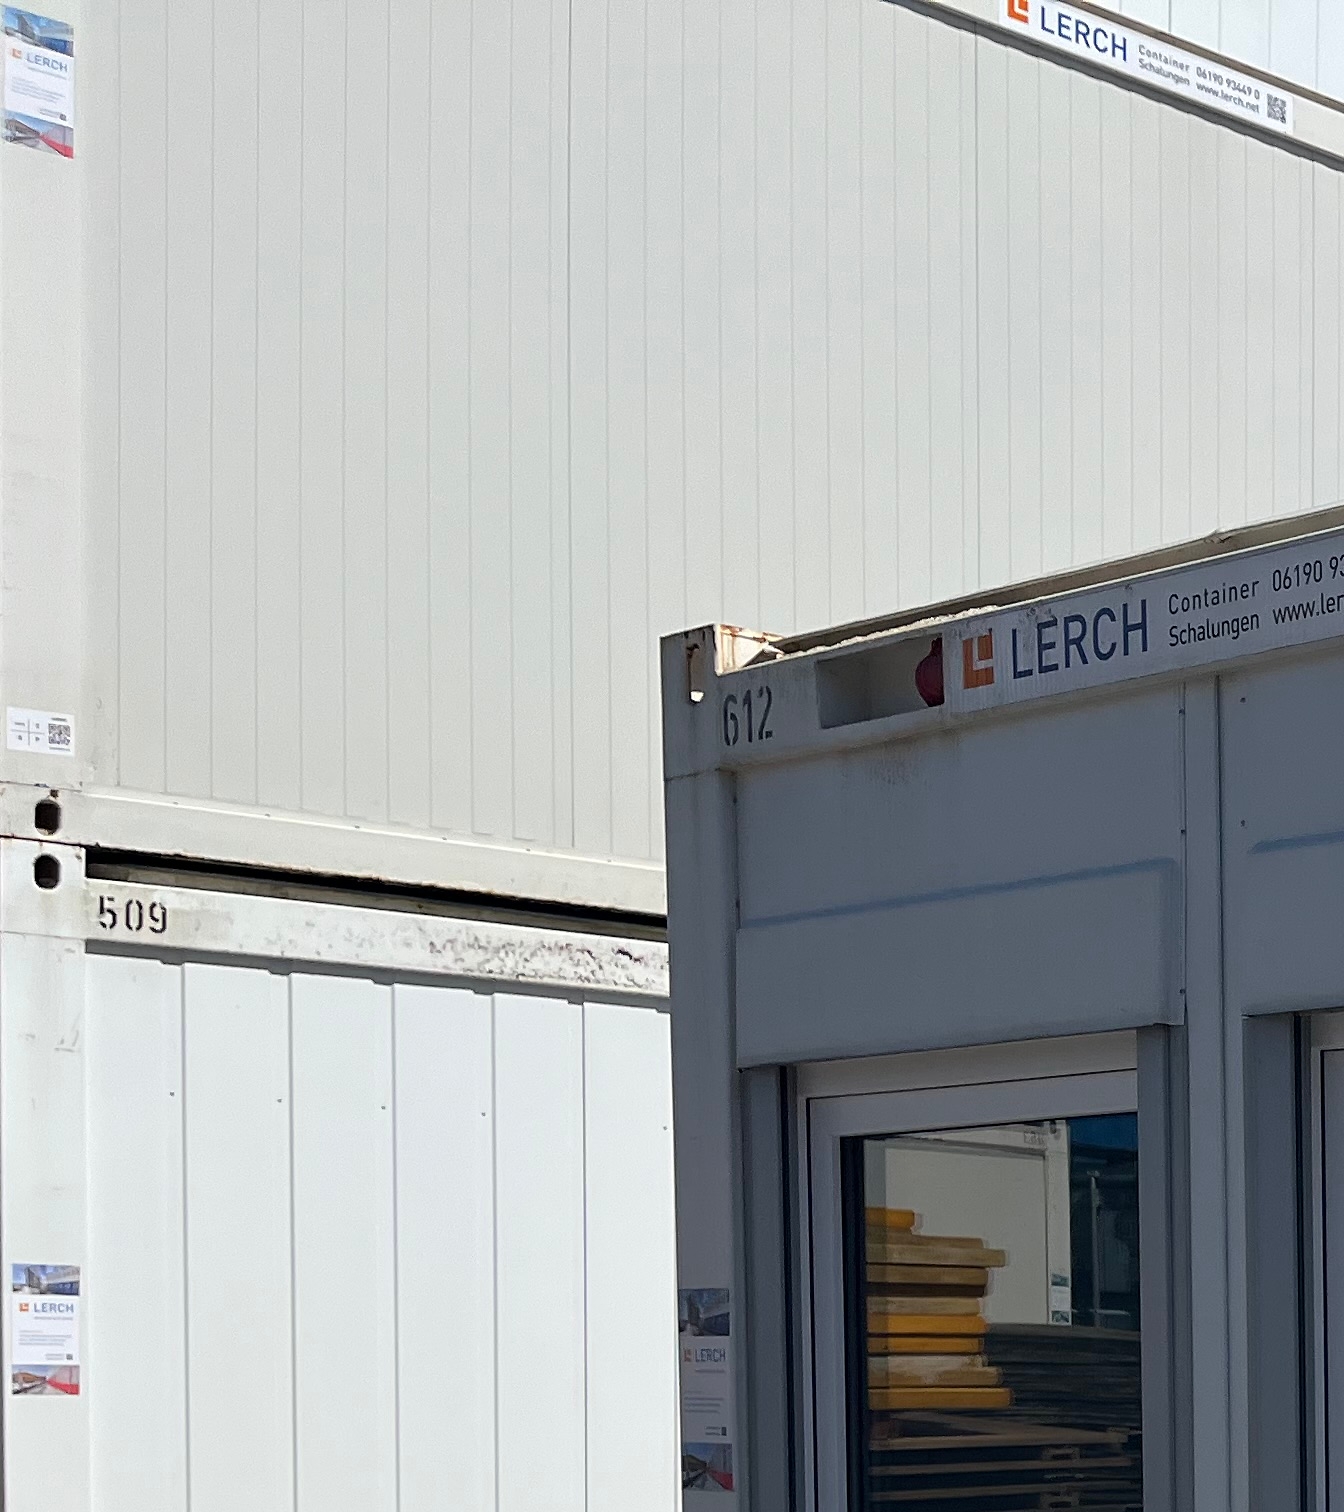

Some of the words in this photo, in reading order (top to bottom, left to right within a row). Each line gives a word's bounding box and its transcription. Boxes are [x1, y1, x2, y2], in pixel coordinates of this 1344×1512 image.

[1041, 7, 1128, 62] LERCH
[26, 52, 68, 73] LERCH
[1138, 44, 1190, 72] Container
[1138, 58, 1190, 87] Schalungen
[1196, 81, 1260, 114] www.lerch.net
[1168, 577, 1260, 615] Container
[1272, 560, 1323, 593] 06190
[1012, 599, 1149, 680] LERCH
[1169, 613, 1260, 648] Schalungen
[723, 685, 773, 747] 612
[99, 895, 168, 934] 509
[34, 1302, 75, 1313] LERCH
[694, 1348, 726, 1363] LERCH
